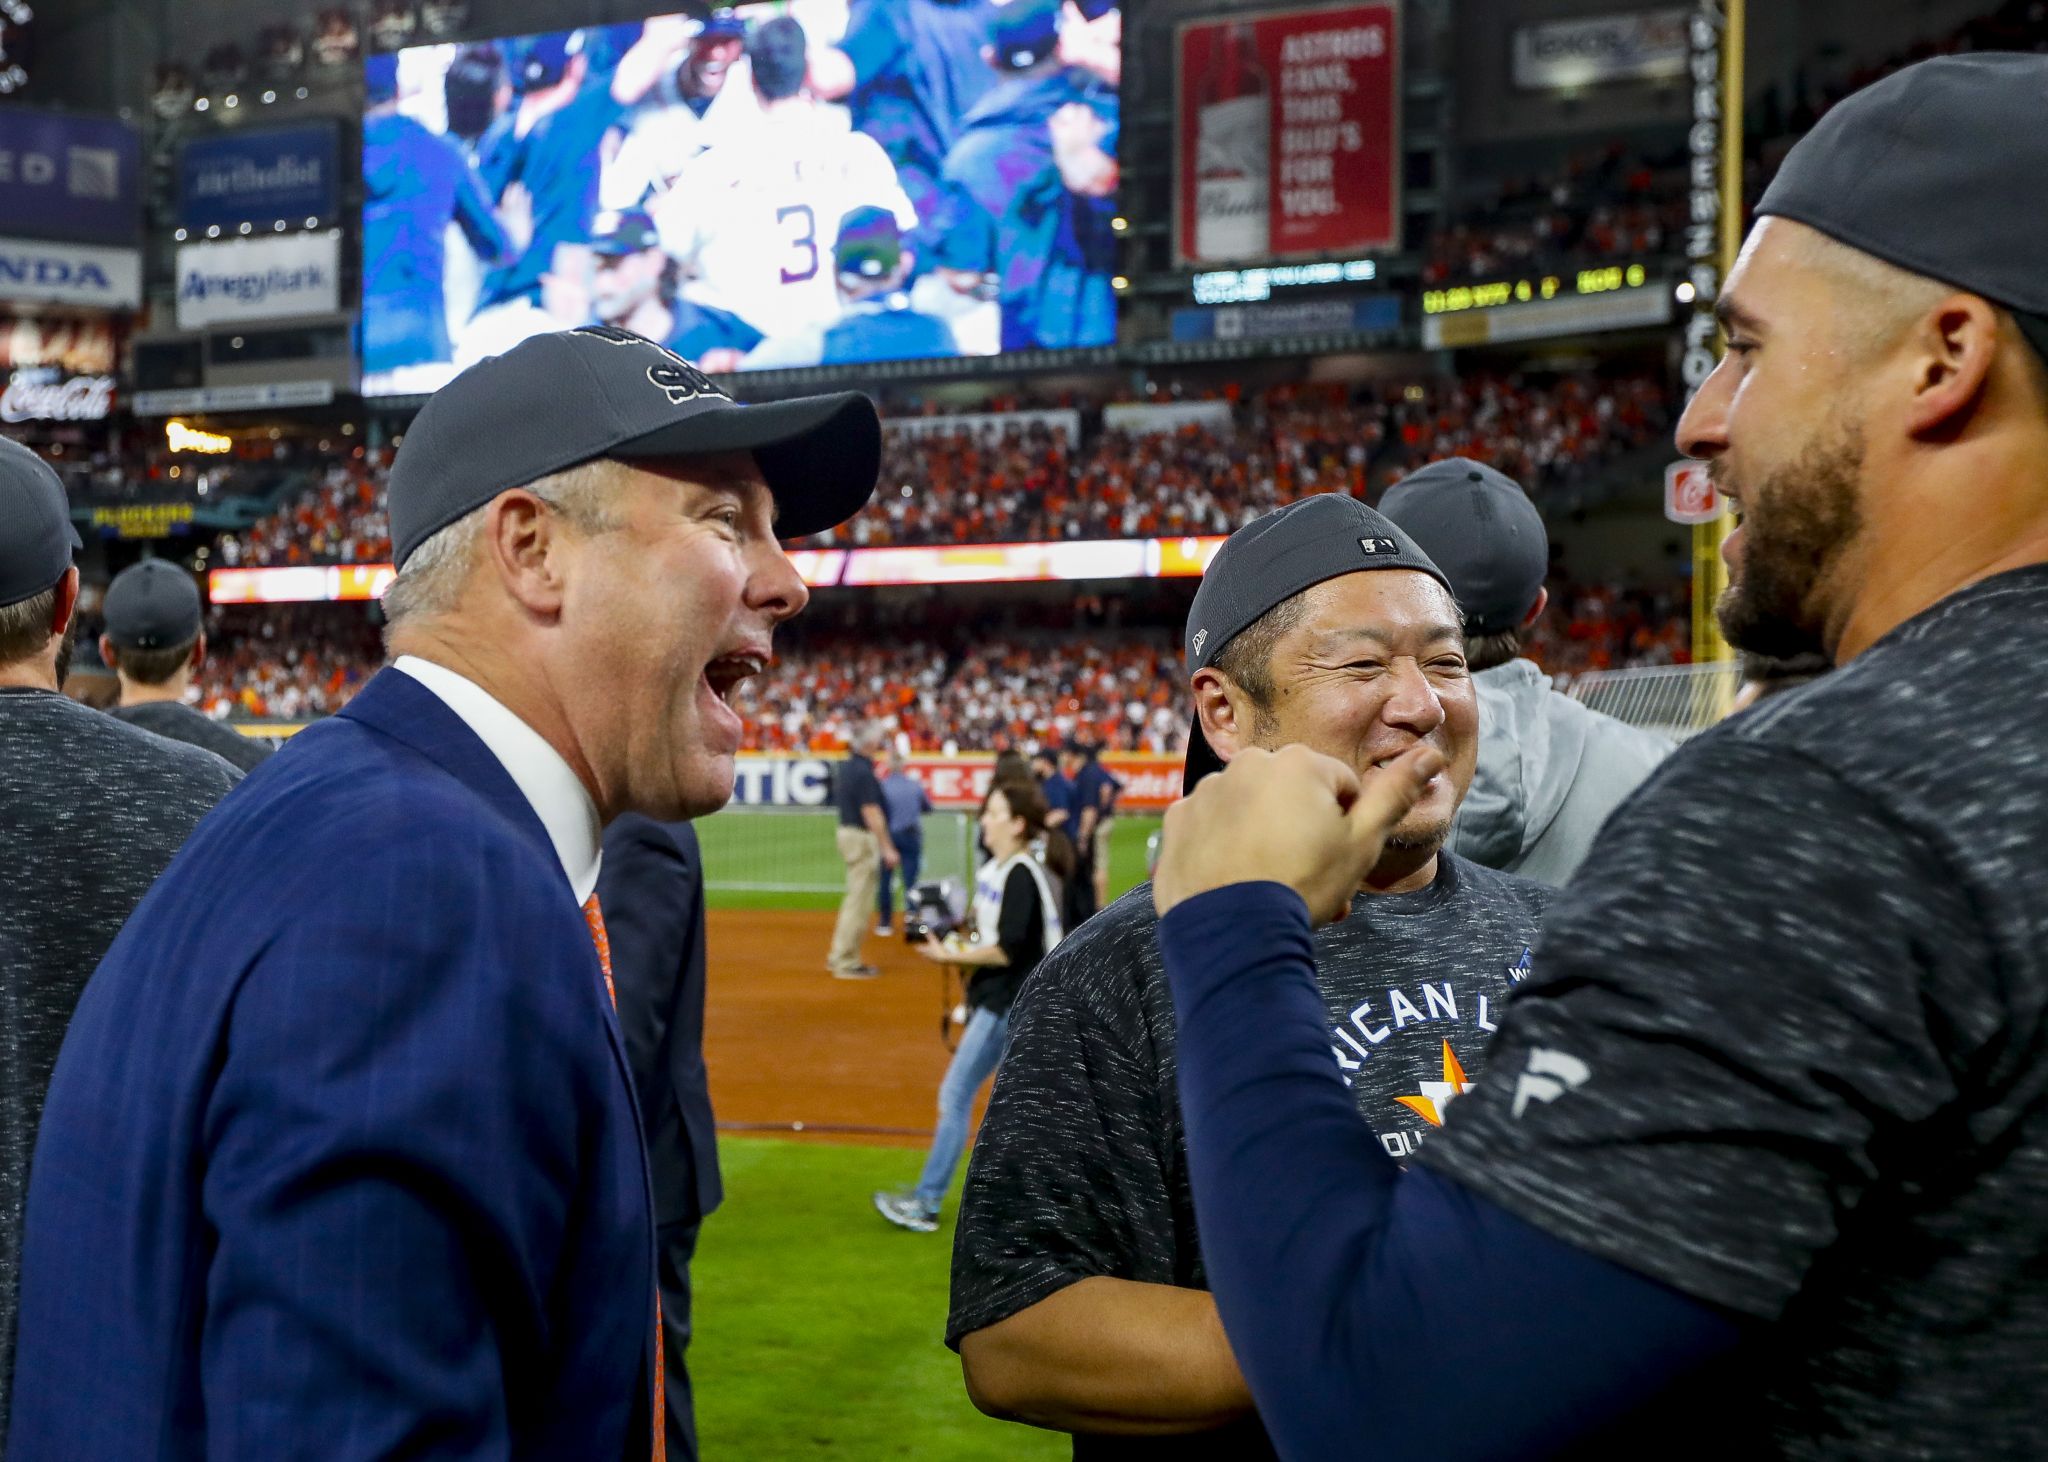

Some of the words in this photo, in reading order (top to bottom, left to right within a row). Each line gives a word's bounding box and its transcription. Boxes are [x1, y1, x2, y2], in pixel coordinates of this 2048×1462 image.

[1281, 25, 1385, 62] ASTROS
[1282, 95, 1342, 123] THIS
[1281, 156, 1334, 185] FOR
[776, 203, 820, 285] 3
[730, 761, 829, 805] TIC
[1330, 981, 1460, 1088] ICAN
[1376, 1130, 1423, 1157] OU
